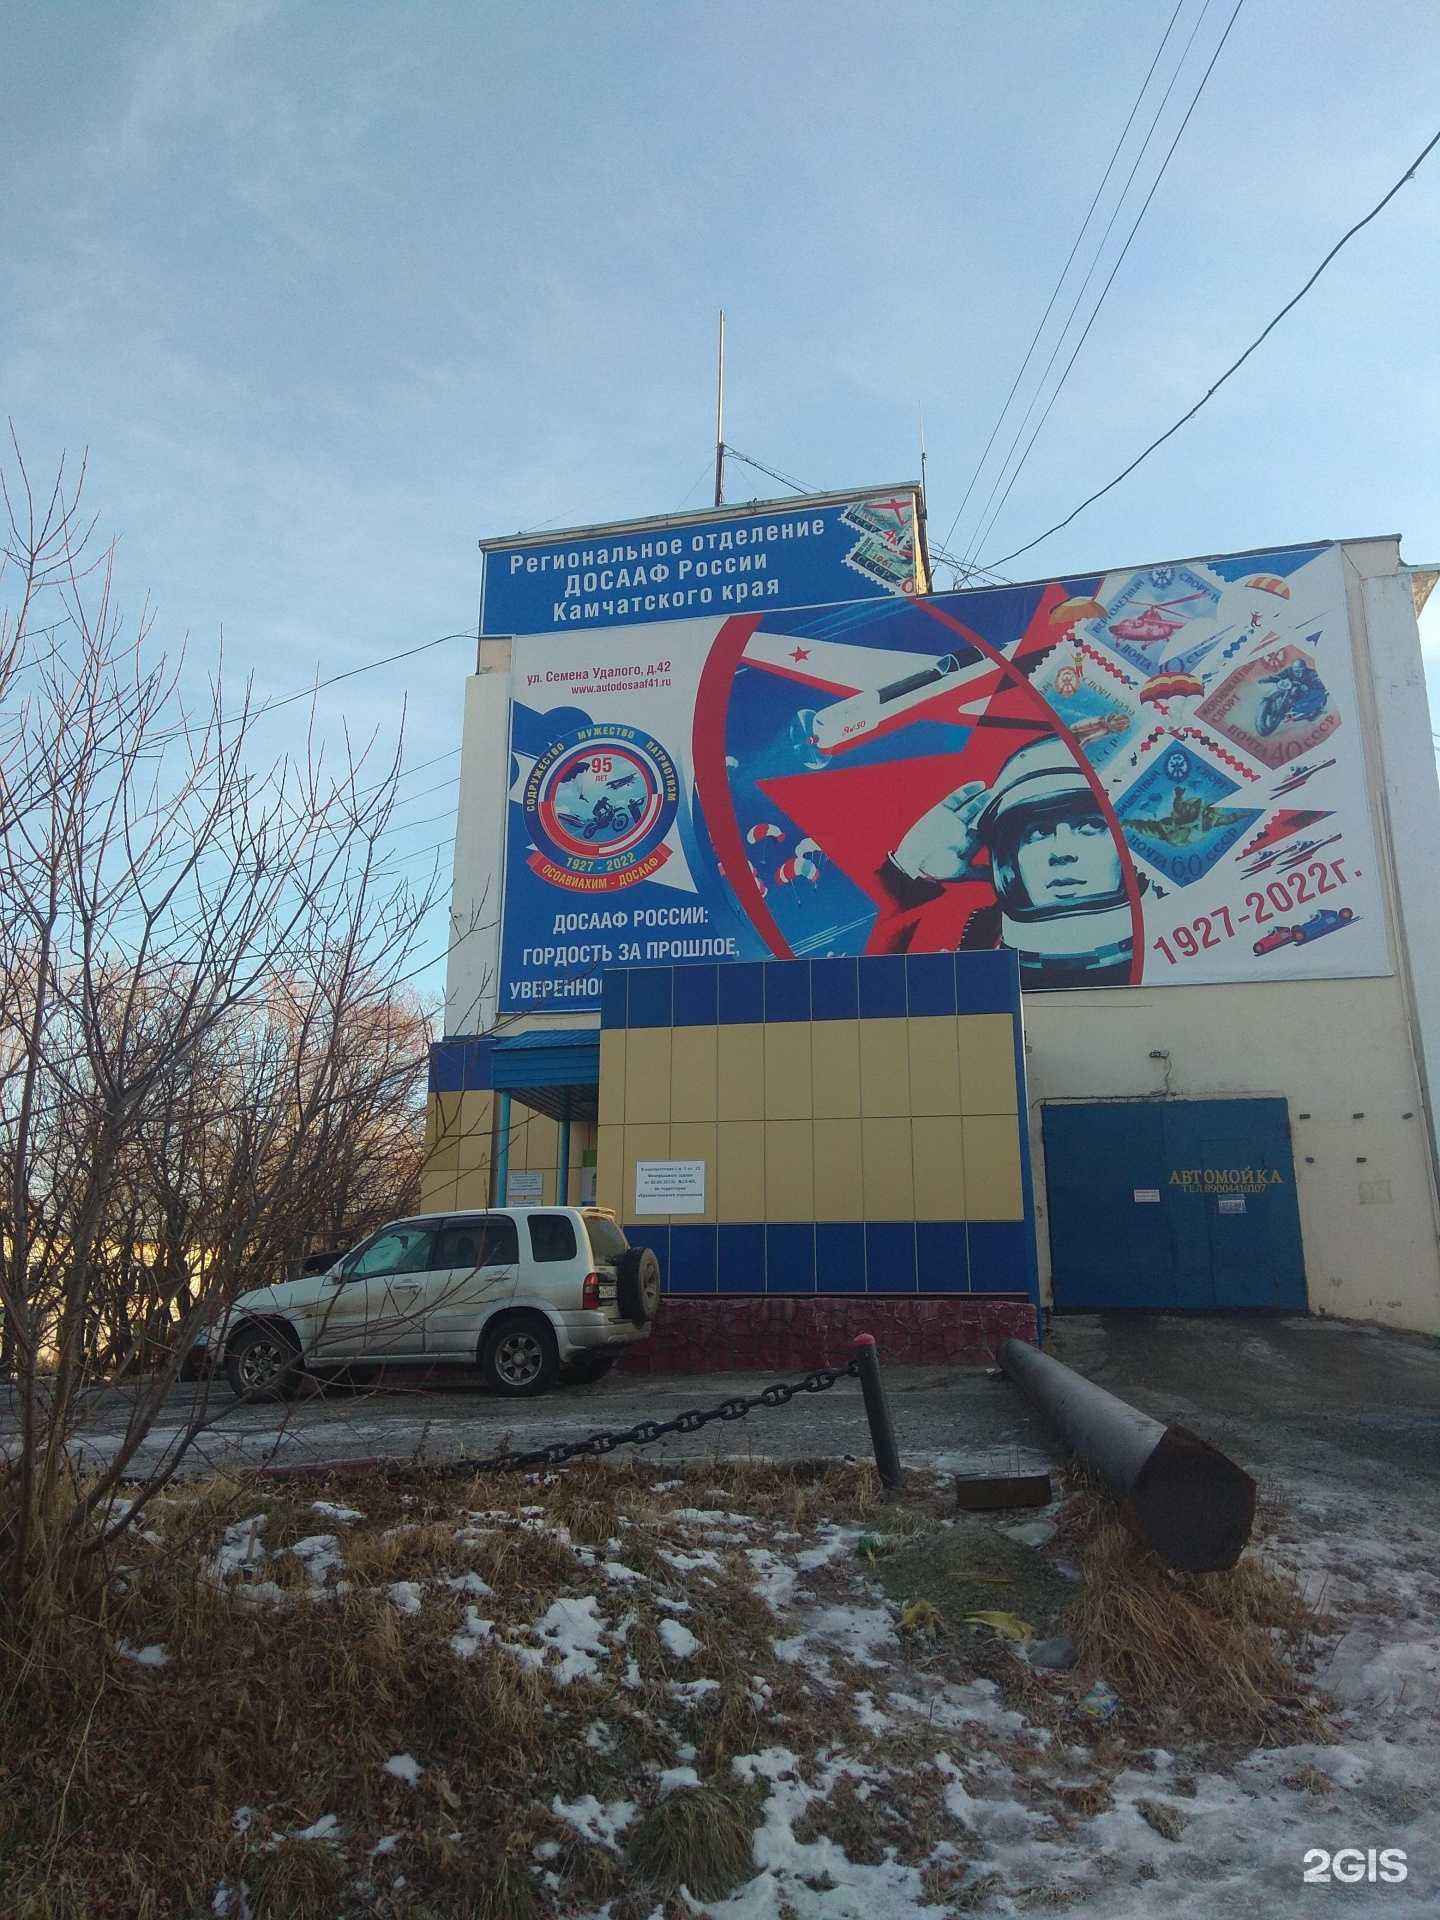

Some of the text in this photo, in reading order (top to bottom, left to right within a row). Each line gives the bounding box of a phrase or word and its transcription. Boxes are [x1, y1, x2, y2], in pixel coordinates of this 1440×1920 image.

[510, 537, 684, 575] Региональное
[691, 517, 826, 551] отделение
[564, 552, 768, 597] ДОСААФ России
[553, 580, 780, 622] Камчатского края
[527, 660, 671, 685] ул. Семена Удалого, д.42
[571, 677, 672, 696] www.autodosaaf41.ru
[577, 726, 636, 741] МУЖЕСТВО
[526, 742, 565, 812] СОДРУЖЕСТВО
[591, 757, 613, 774] 95
[595, 774, 608, 783] ЛЕТ
[645, 740, 676, 802] ПАТРИОТИЗМ
[541, 863, 608, 889] ОСОАВИАХИМ
[619, 856, 658, 888] ДОСААФ
[566, 857, 593, 872] 1927
[606, 851, 637, 871] 2022
[1171, 852, 1203, 879] 60
[552, 905, 710, 936] ДОСААФ РОССИИ:
[1153, 857, 1362, 965] 1927-2022г.
[523, 937, 740, 967] ГОРДОСТЬ ЗА ПРОШЛОЕ,
[509, 977, 602, 1000] УВЕРЕННО
[1169, 1166, 1283, 1184] АВТОМОЙКА
